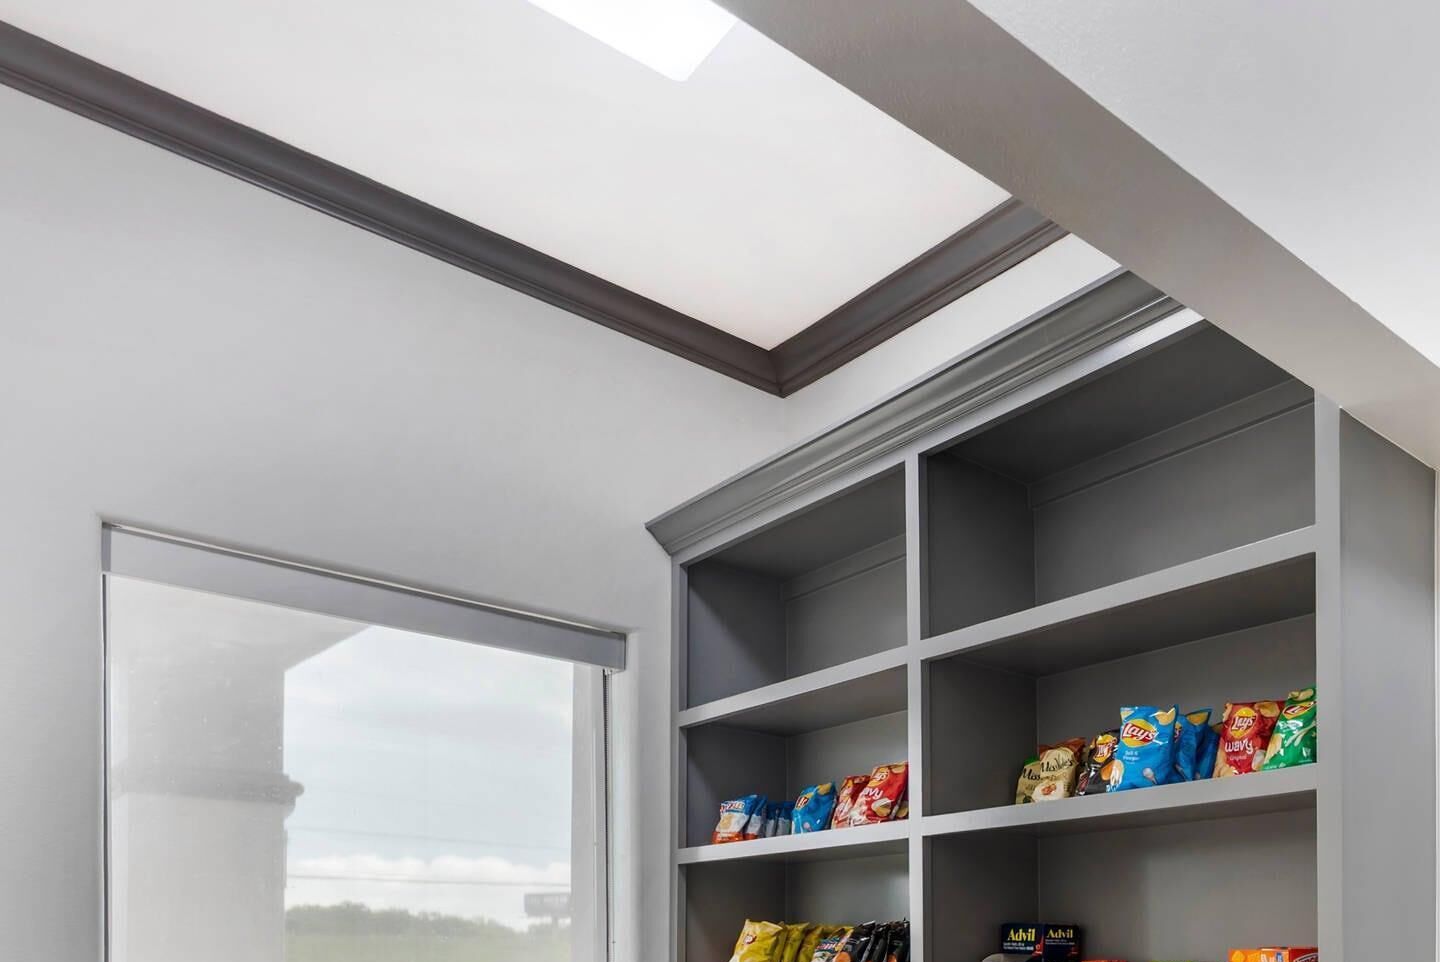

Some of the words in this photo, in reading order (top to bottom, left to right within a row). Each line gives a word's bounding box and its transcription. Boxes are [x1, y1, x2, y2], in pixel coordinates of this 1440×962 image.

[1121, 721, 1157, 741] Lay's
[1225, 738, 1253, 754] wavy
[1007, 928, 1036, 941] Advil
[1046, 929, 1073, 939] Advil
